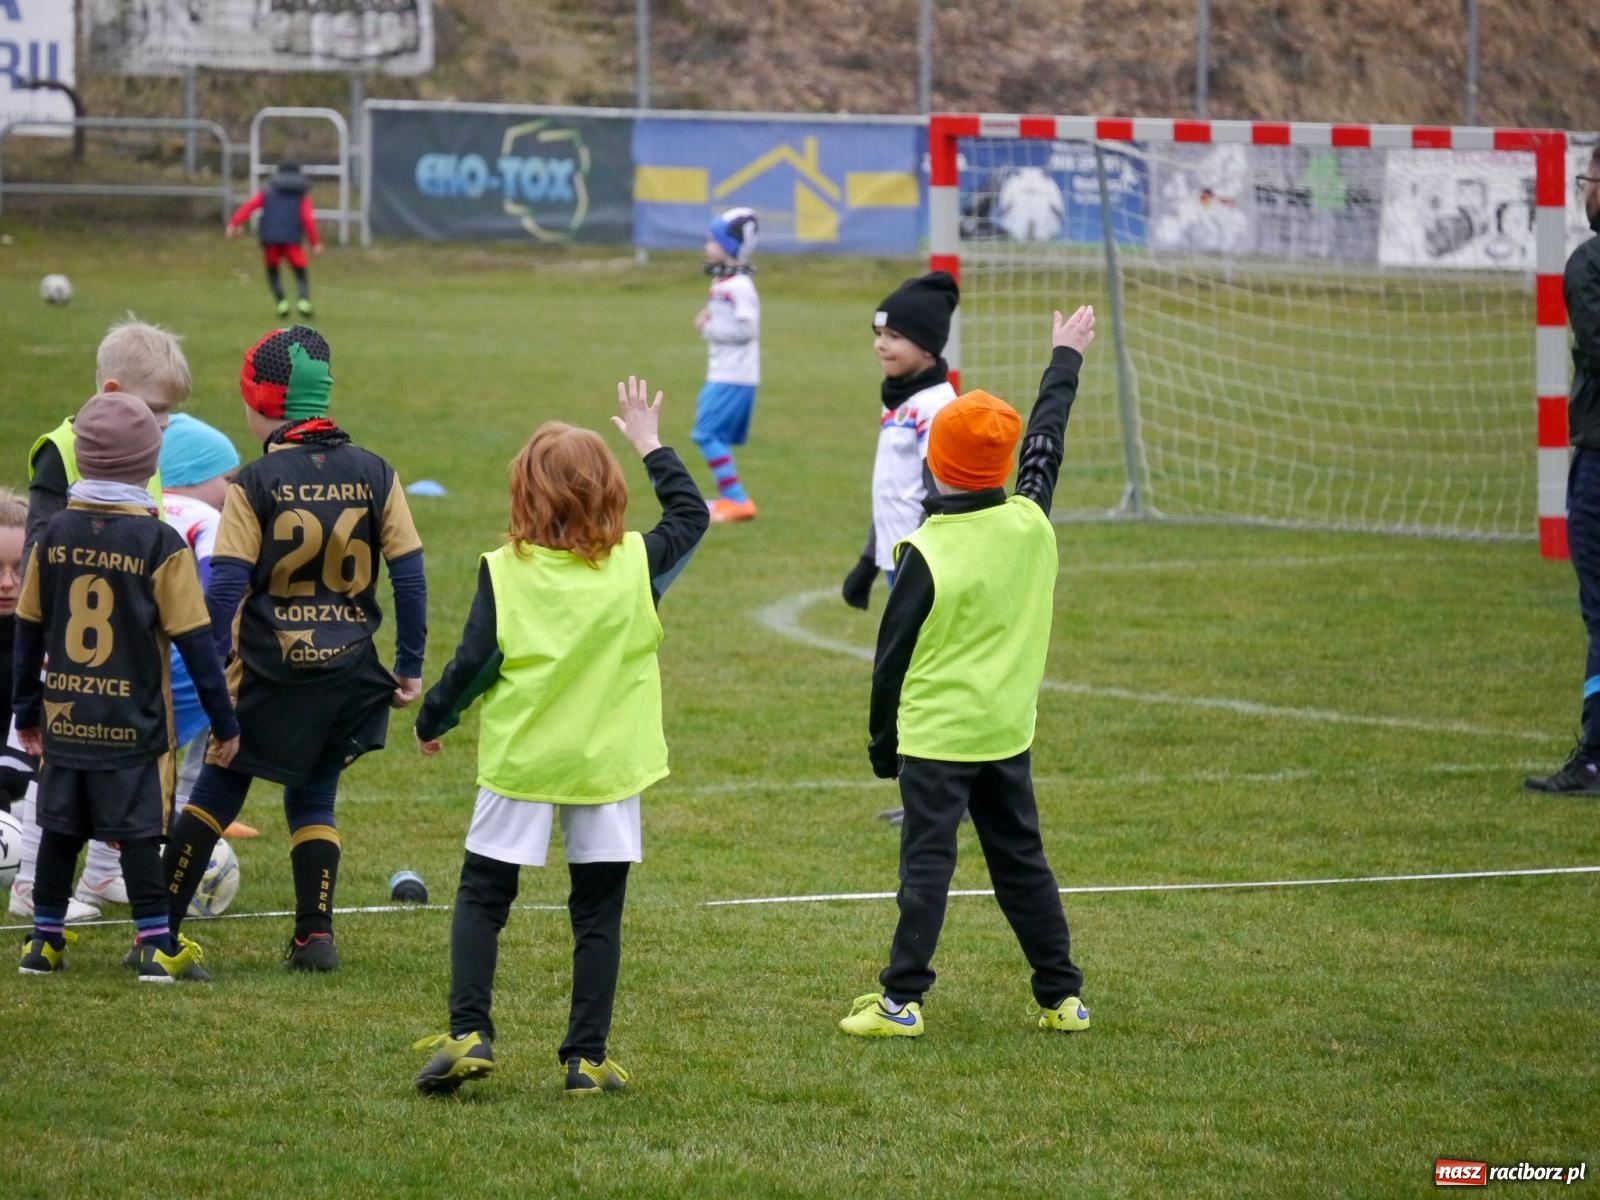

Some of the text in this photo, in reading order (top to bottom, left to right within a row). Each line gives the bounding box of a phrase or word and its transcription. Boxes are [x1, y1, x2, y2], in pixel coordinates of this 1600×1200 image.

[48, 546, 144, 575] KS CZARNI
[268, 507, 372, 598] 26
[65, 574, 114, 668] 8
[47, 672, 130, 697] GORZYCE
[52, 719, 137, 740] abastran
[318, 868, 331, 912] 1924
